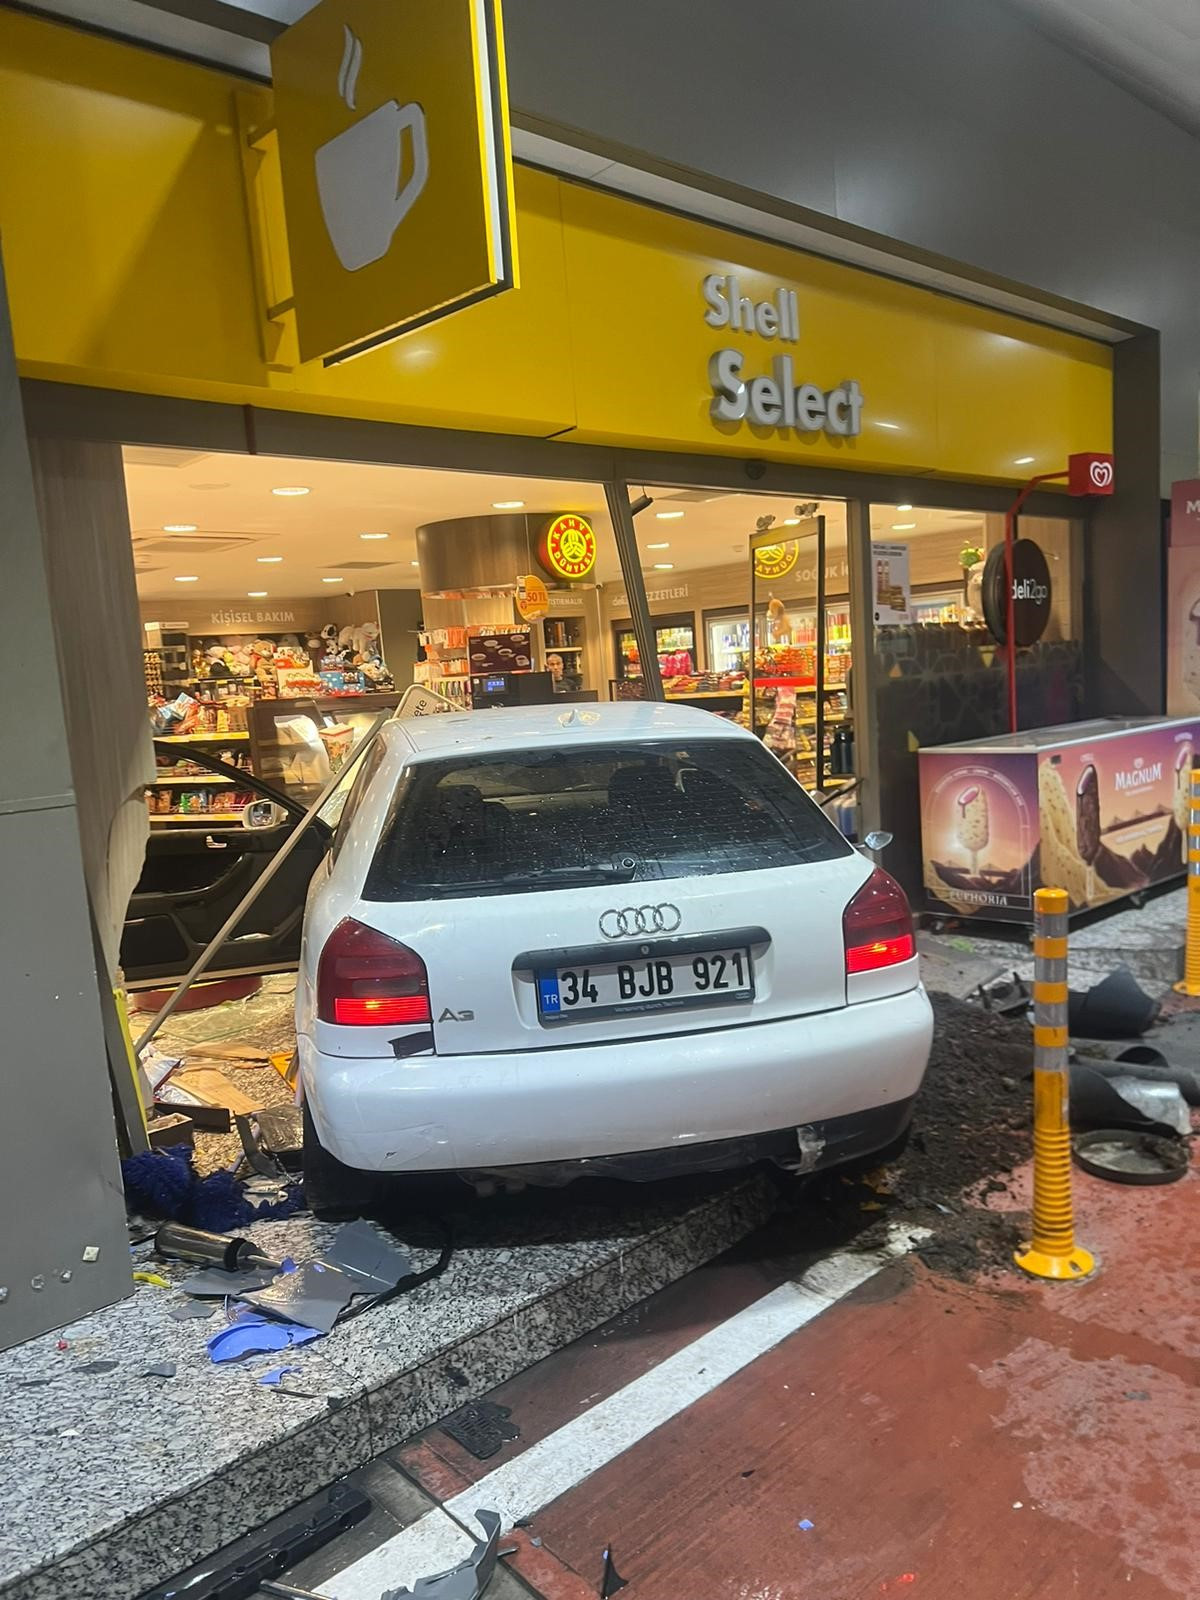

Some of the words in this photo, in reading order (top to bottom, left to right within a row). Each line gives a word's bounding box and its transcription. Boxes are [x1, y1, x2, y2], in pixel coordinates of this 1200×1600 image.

[703, 273, 799, 344] Shell
[709, 349, 864, 437] Select
[553, 519, 591, 540] KAHVE
[554, 551, 592, 573] DÜNYASI
[1010, 578, 1048, 605] deli2go
[211, 609, 254, 626] KİŞİSEL
[256, 611, 295, 622] BAKIM
[413, 699, 427, 717] ete
[1115, 762, 1162, 791] MAGNUM
[950, 890, 1008, 906] EUPHORIA
[561, 969, 598, 1006] 34
[618, 961, 674, 999] BJB
[692, 952, 745, 990] 921
[544, 994, 559, 1005] TR
[438, 1007, 474, 1023] A3
